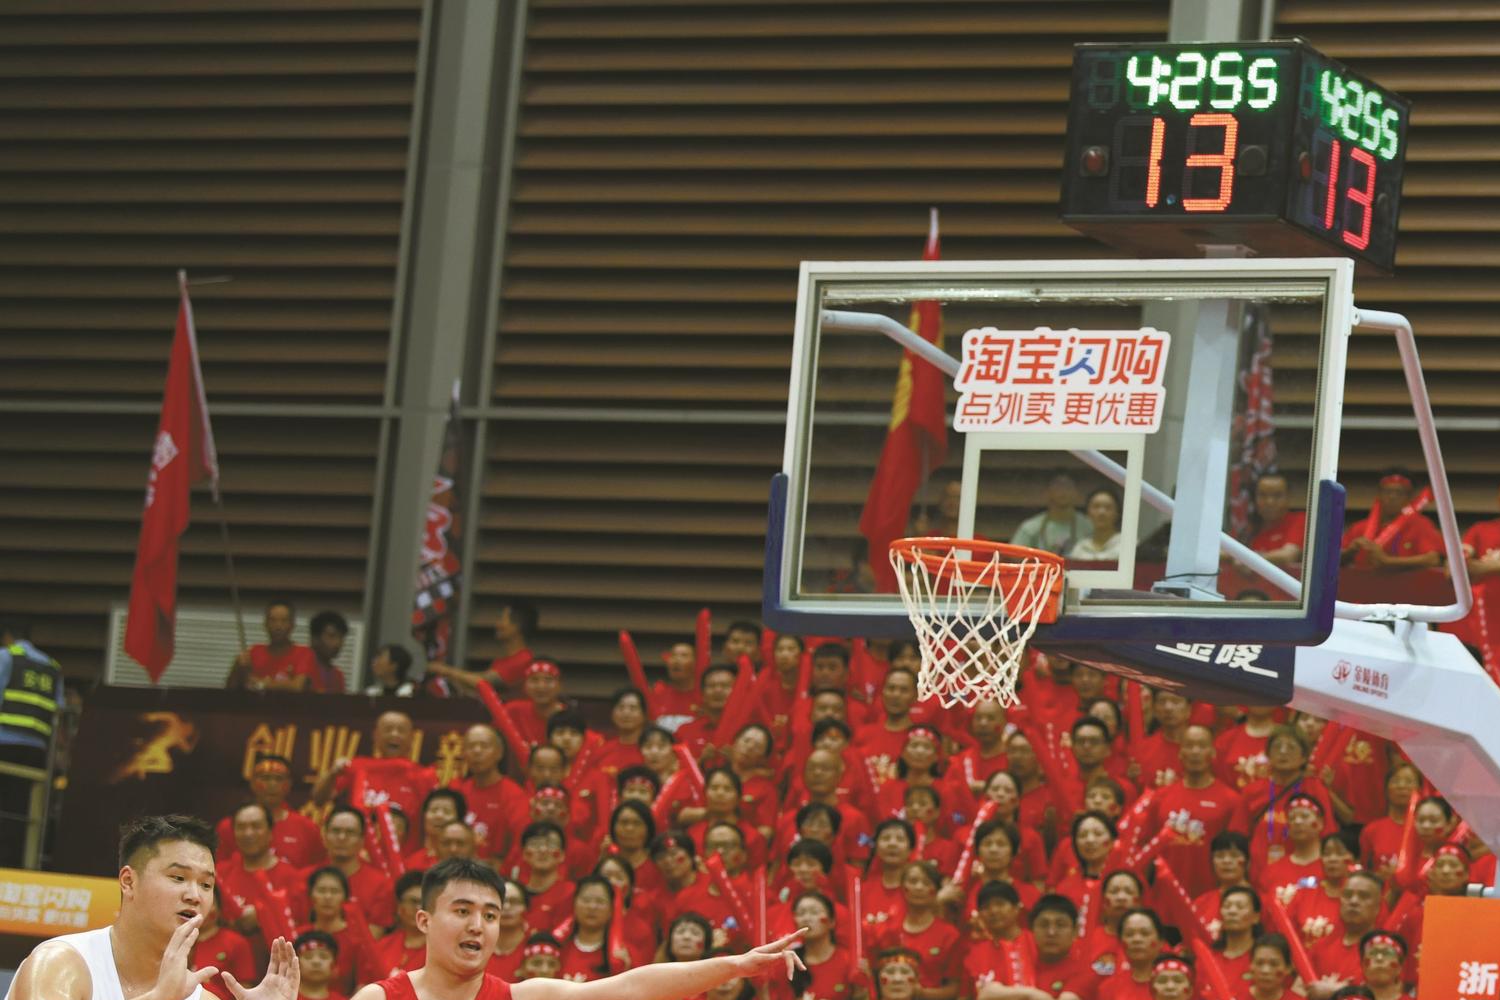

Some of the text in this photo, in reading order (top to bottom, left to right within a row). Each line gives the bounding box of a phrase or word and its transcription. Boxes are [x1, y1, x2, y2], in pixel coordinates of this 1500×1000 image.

[1145, 112, 1239, 212] 13
[1325, 138, 1377, 250] 13
[961, 335, 1164, 385] 淘宝闪购
[960, 391, 1159, 427] 点外卖 更优惠
